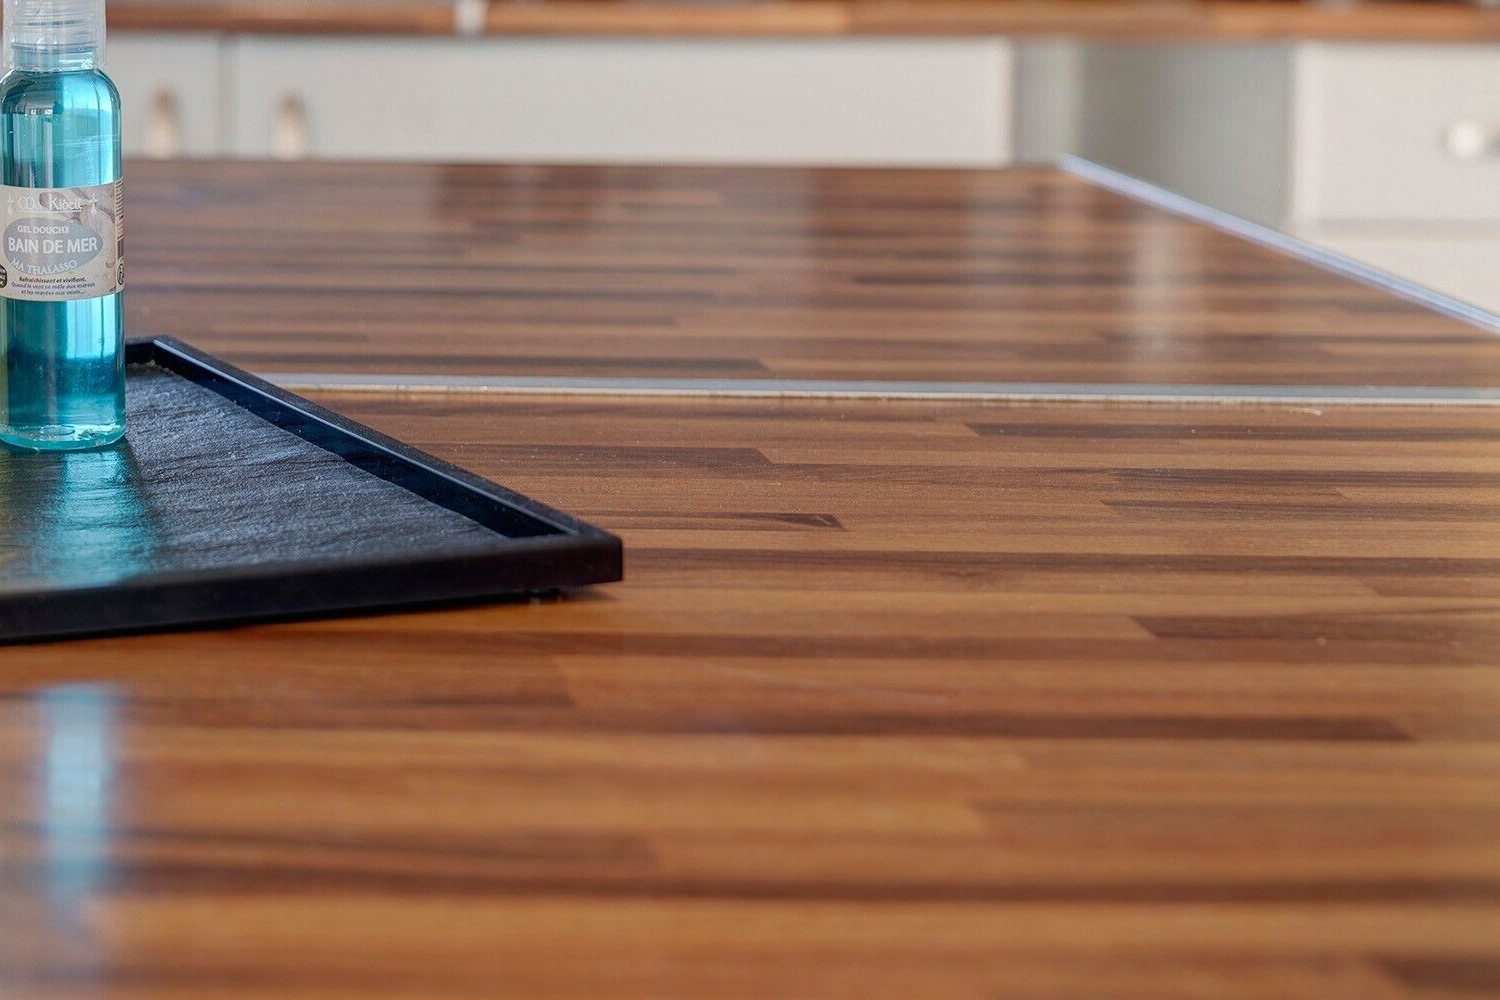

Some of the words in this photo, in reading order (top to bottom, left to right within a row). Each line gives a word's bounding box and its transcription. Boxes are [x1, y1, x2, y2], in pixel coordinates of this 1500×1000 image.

[17, 225, 32, 234] GEL
[33, 226, 69, 234] DOUCHE
[8, 237, 39, 254] BAIN
[43, 239, 64, 254] DE
[67, 237, 98, 253] MER
[11, 258, 24, 271] MA
[27, 260, 77, 275] THALASSO
